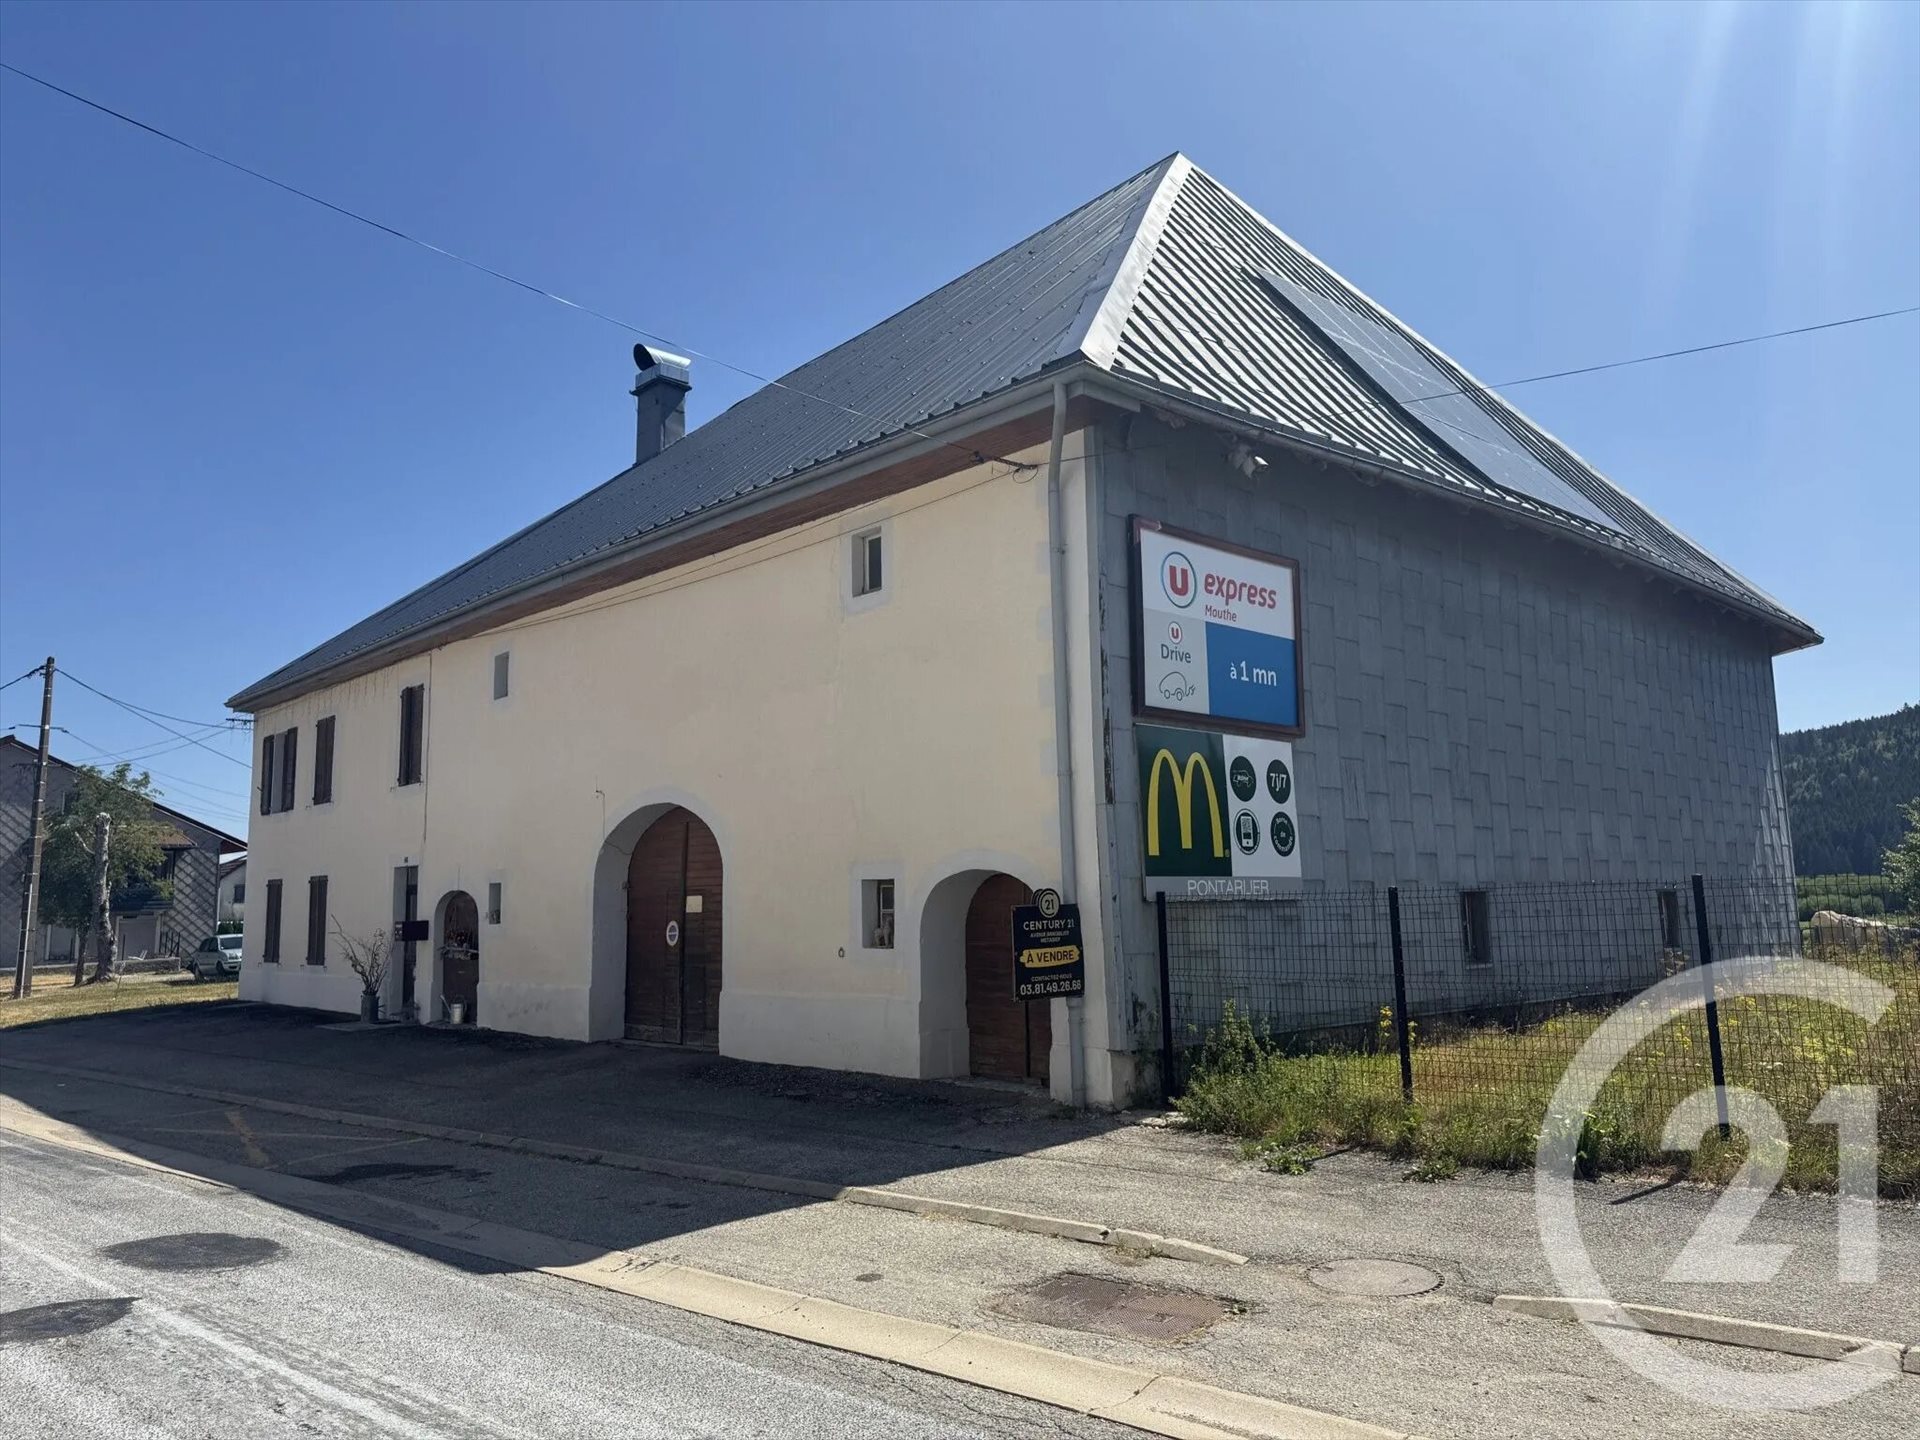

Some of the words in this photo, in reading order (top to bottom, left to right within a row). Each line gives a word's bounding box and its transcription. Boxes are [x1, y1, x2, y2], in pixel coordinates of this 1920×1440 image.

[1204, 573, 1277, 609] express
[1205, 605, 1237, 622] Mouthe
[1161, 643, 1191, 663] Drive
[1230, 661, 1237, 680] à
[1240, 660, 1249, 682] 1
[1253, 667, 1277, 686] mn
[1187, 879, 1269, 896] PONTARLIER
[1045, 899, 1055, 911] 21
[1023, 919, 1066, 931] CENTURY
[1067, 919, 1075, 928] 21
[1036, 950, 1075, 963] VENDRE
